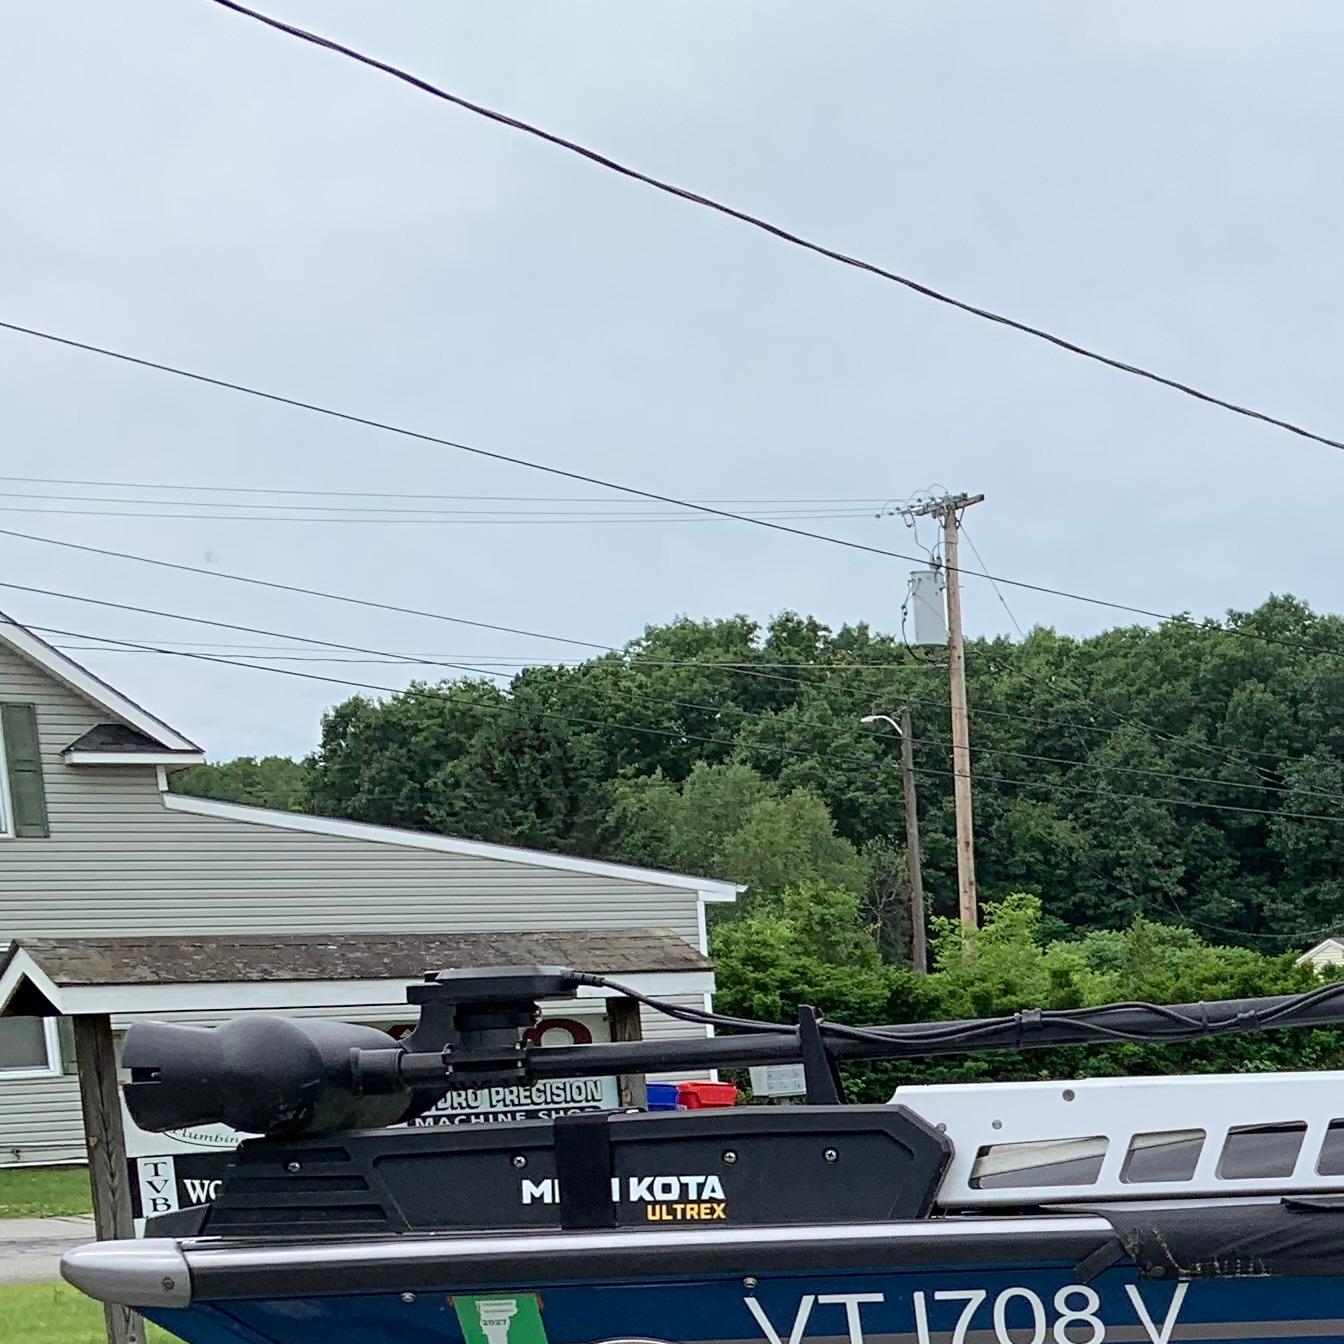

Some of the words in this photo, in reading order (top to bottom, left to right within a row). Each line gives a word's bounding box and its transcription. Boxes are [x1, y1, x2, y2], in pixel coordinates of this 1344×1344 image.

[491, 1080, 602, 1106] PRECISION
[522, 1178, 620, 1204] MI
[629, 1175, 726, 1201] KOTA
[647, 1203, 726, 1220] ULTREX
